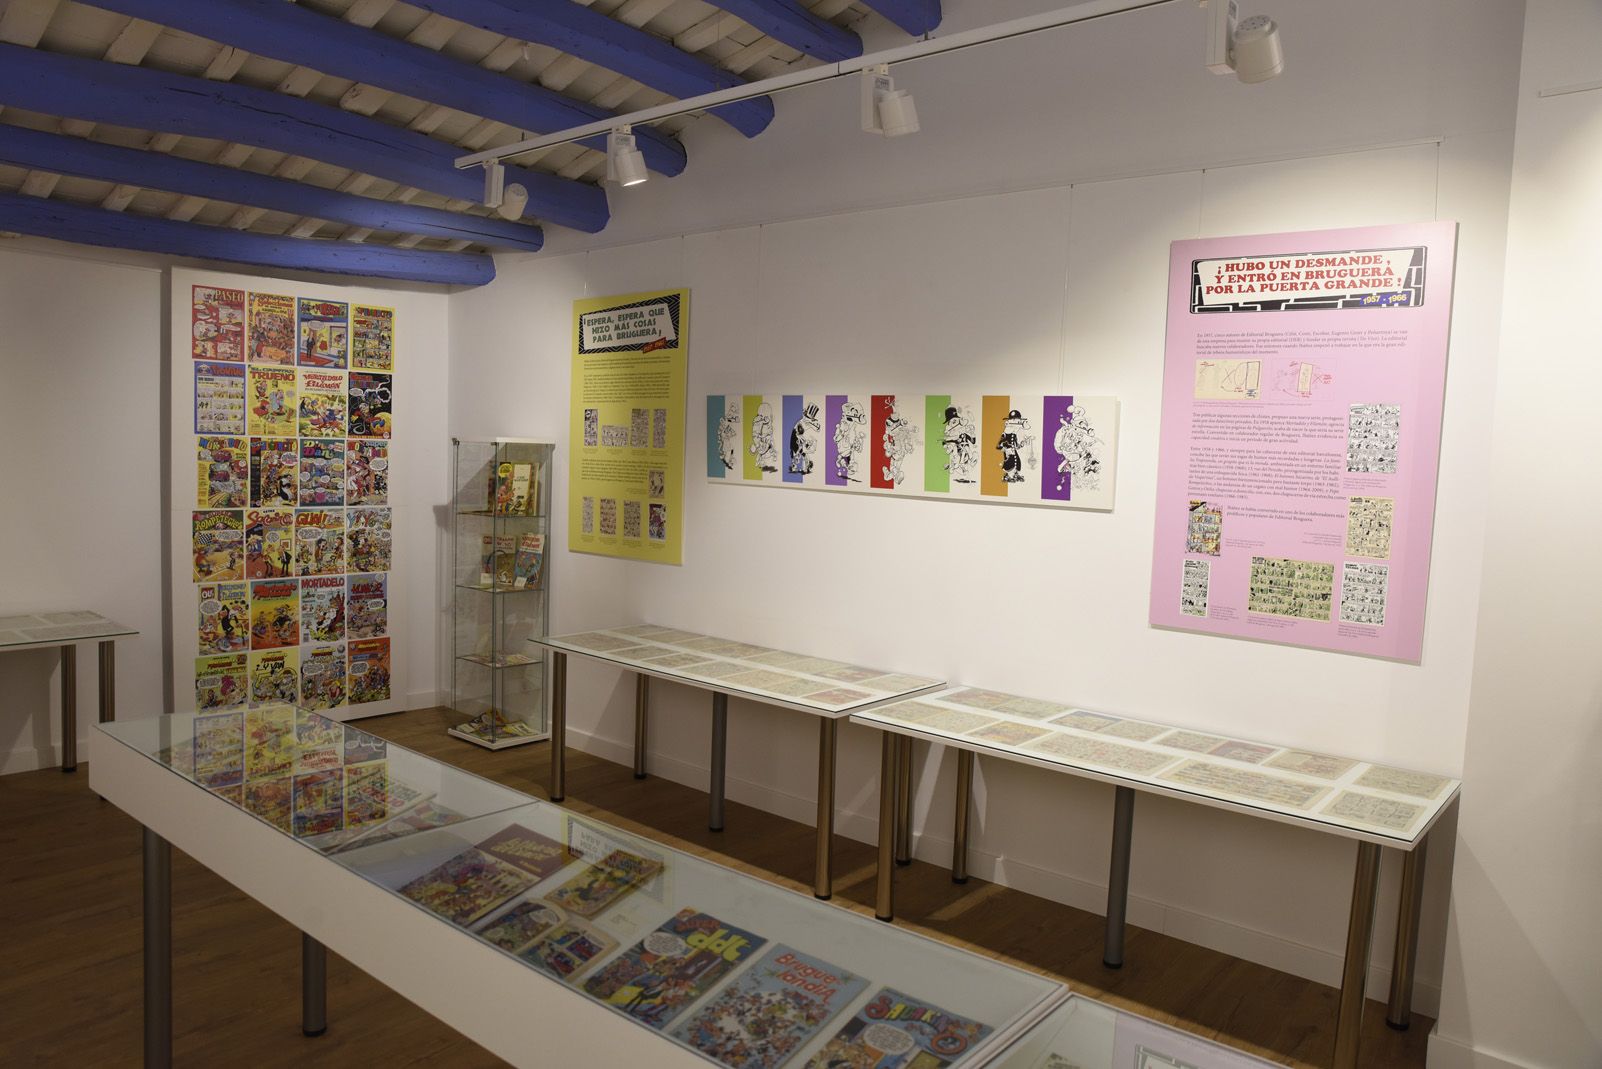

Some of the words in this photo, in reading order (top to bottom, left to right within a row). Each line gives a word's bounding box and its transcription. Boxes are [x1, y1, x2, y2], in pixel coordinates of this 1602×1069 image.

[1269, 260, 1291, 270] UN
[1215, 275, 1224, 284] Y
[1228, 270, 1277, 283] ENTRÓ
[1280, 272, 1300, 280] EN
[1304, 267, 1394, 280] BRUGUERA
[1206, 285, 1233, 294] POR
[1237, 284, 1256, 293] LA
[1260, 281, 1320, 292] PUERTA
[618, 311, 644, 322] ESPERA
[648, 308, 664, 316] QUE
[634, 318, 656, 328] COSAS
[592, 334, 612, 344] PARA
[250, 371, 296, 381] TRUENO
[301, 578, 344, 589] MORTADELO
